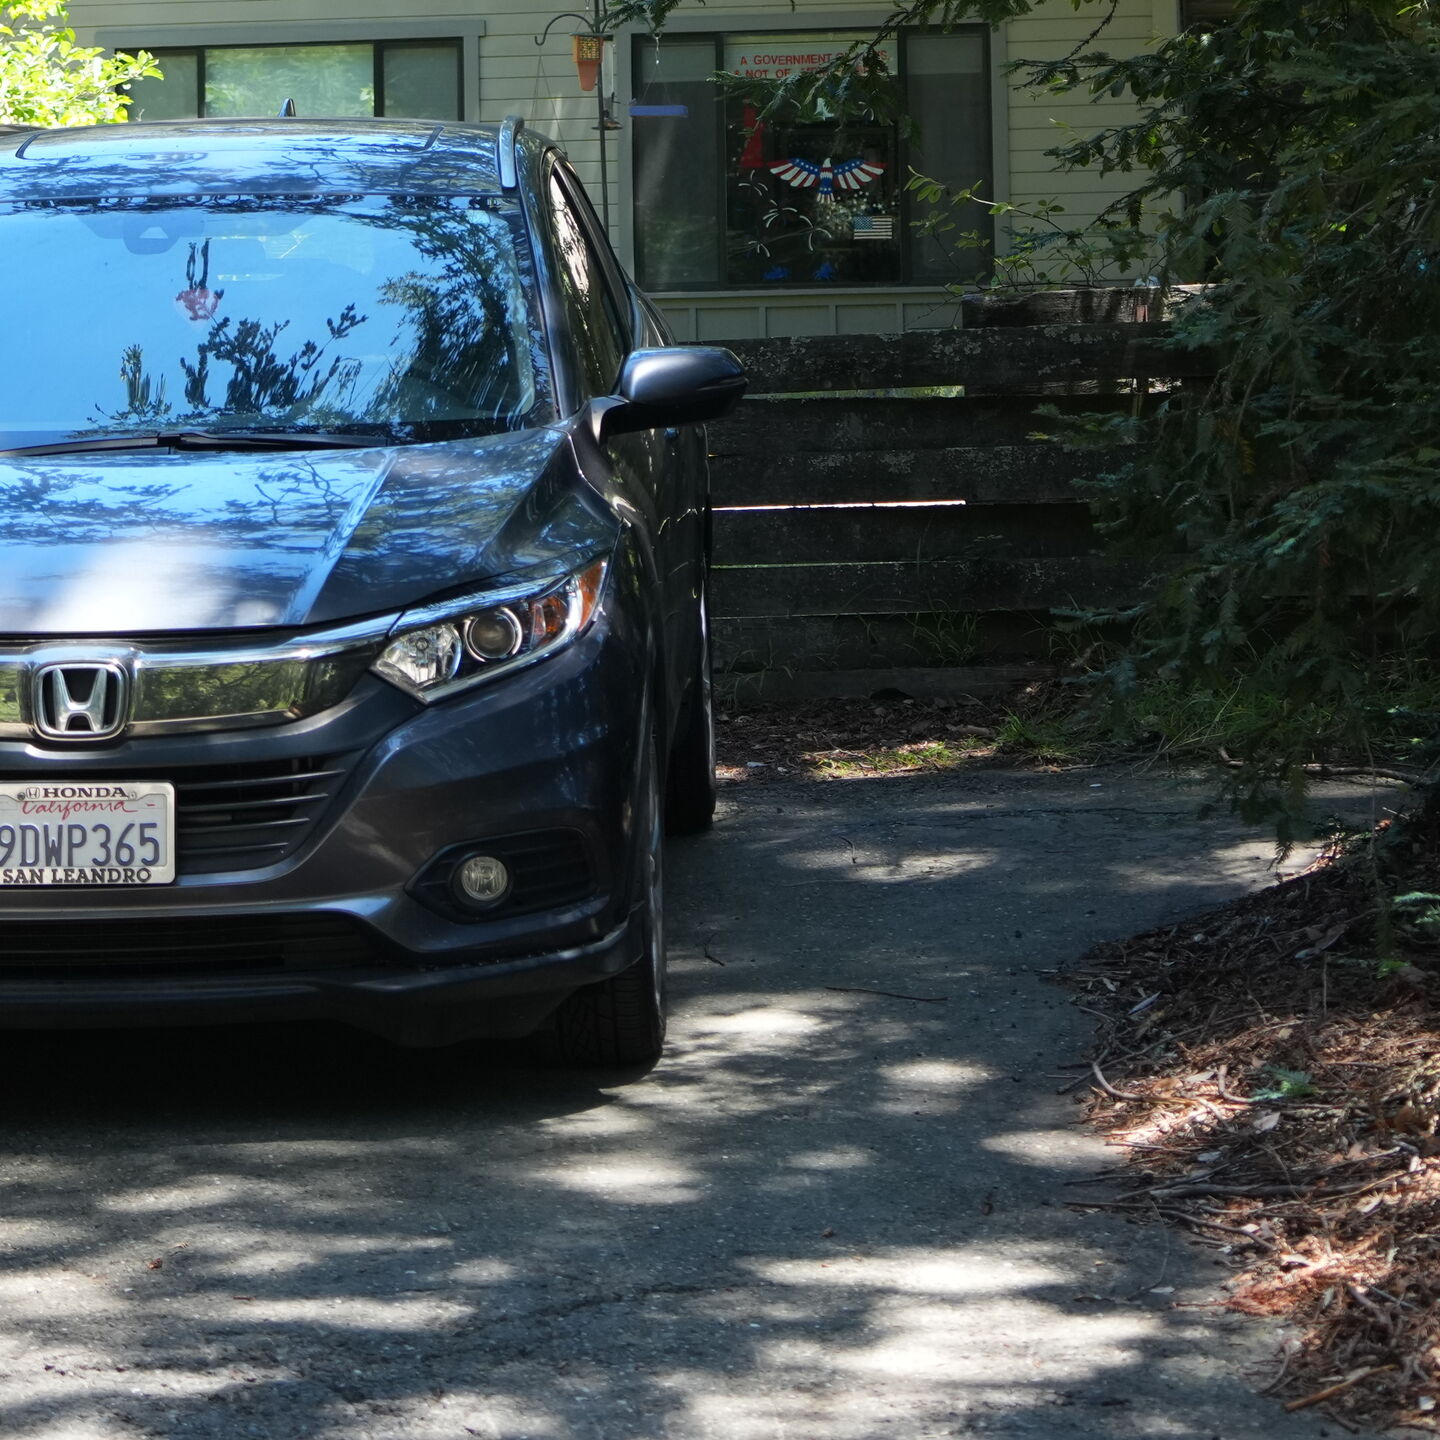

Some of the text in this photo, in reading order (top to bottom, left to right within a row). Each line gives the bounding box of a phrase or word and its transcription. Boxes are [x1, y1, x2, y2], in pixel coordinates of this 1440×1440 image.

[740, 55, 748, 65] A
[753, 53, 833, 65] GOVERNMENT
[745, 69, 769, 79] NOT
[775, 68, 792, 78] OF
[42, 787, 129, 799] HONDA
[21, 800, 138, 820] California
[2, 867, 152, 884] SAN LEANDRO
